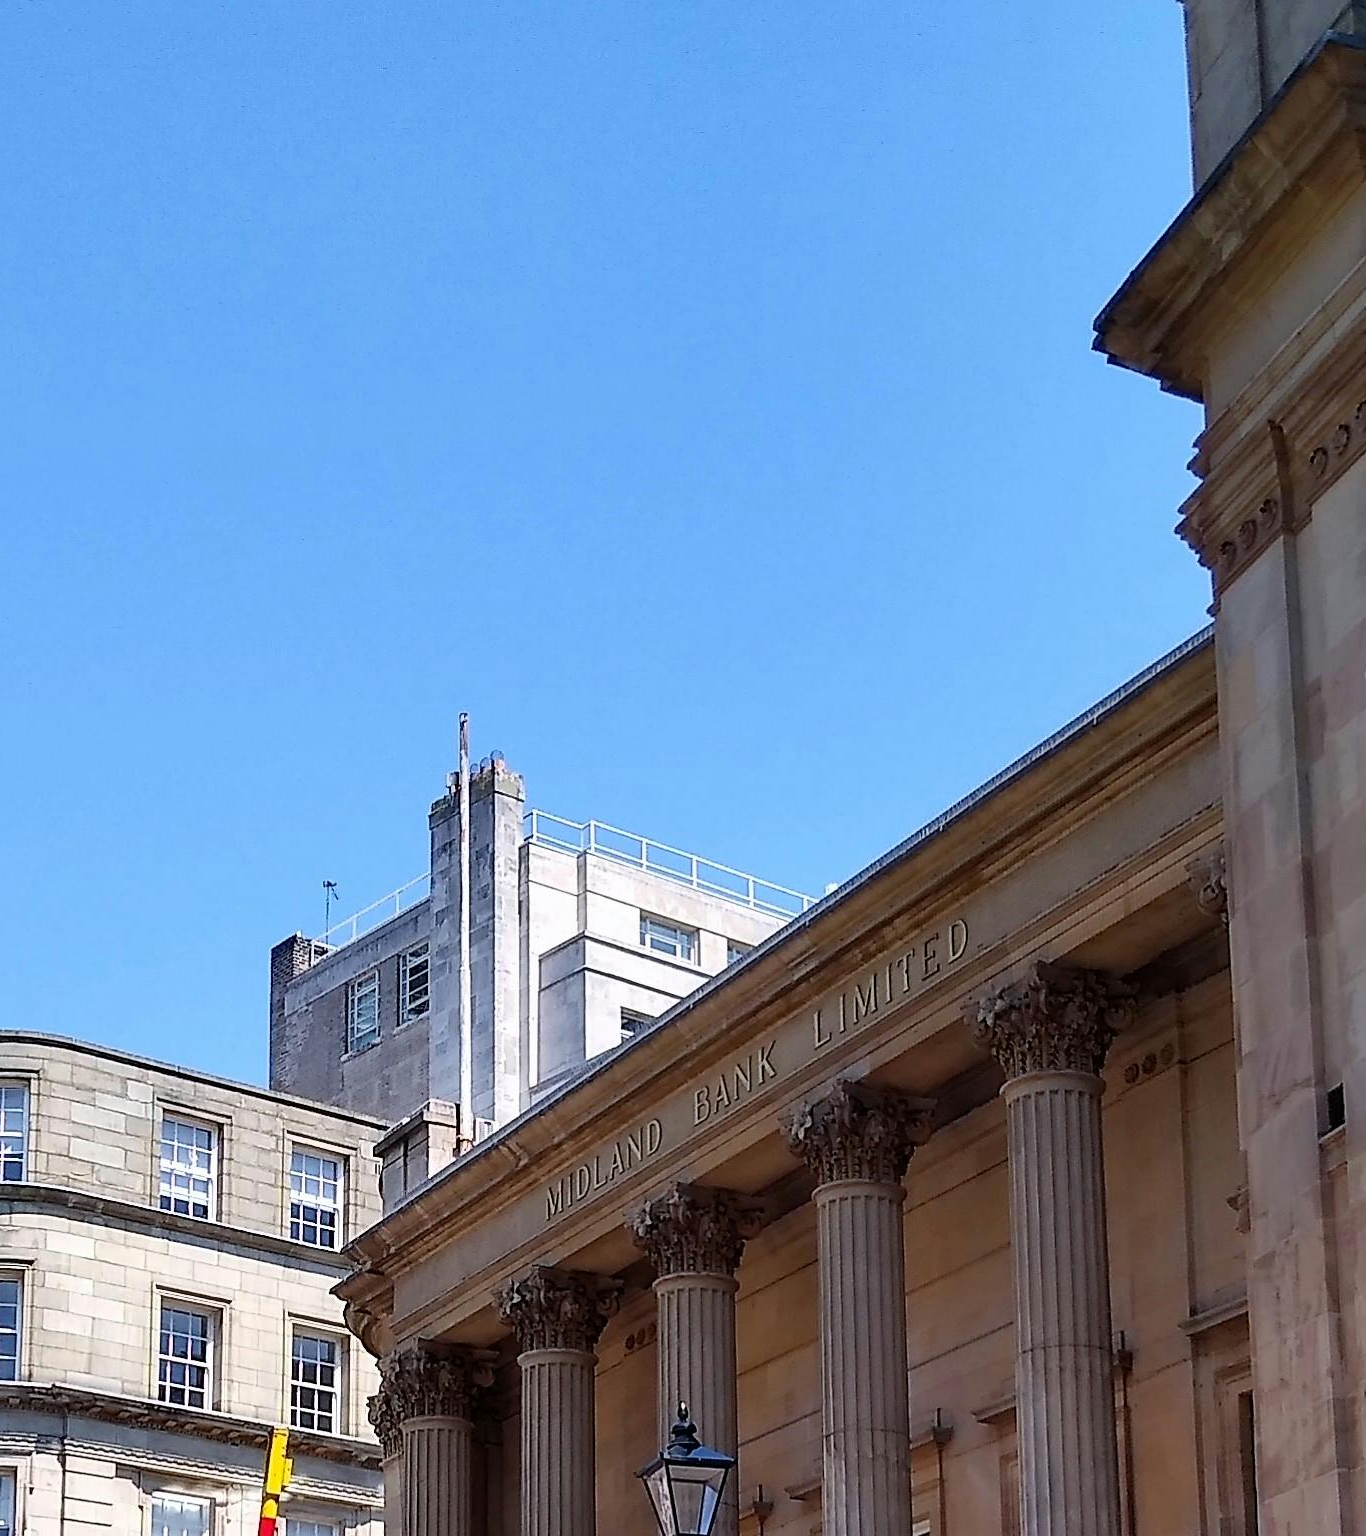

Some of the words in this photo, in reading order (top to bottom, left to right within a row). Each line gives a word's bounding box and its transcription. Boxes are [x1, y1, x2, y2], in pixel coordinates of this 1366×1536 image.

[545, 1118, 663, 1221] MIDLAND
[693, 1040, 777, 1127] BANK
[813, 918, 968, 1050] LIMITED
